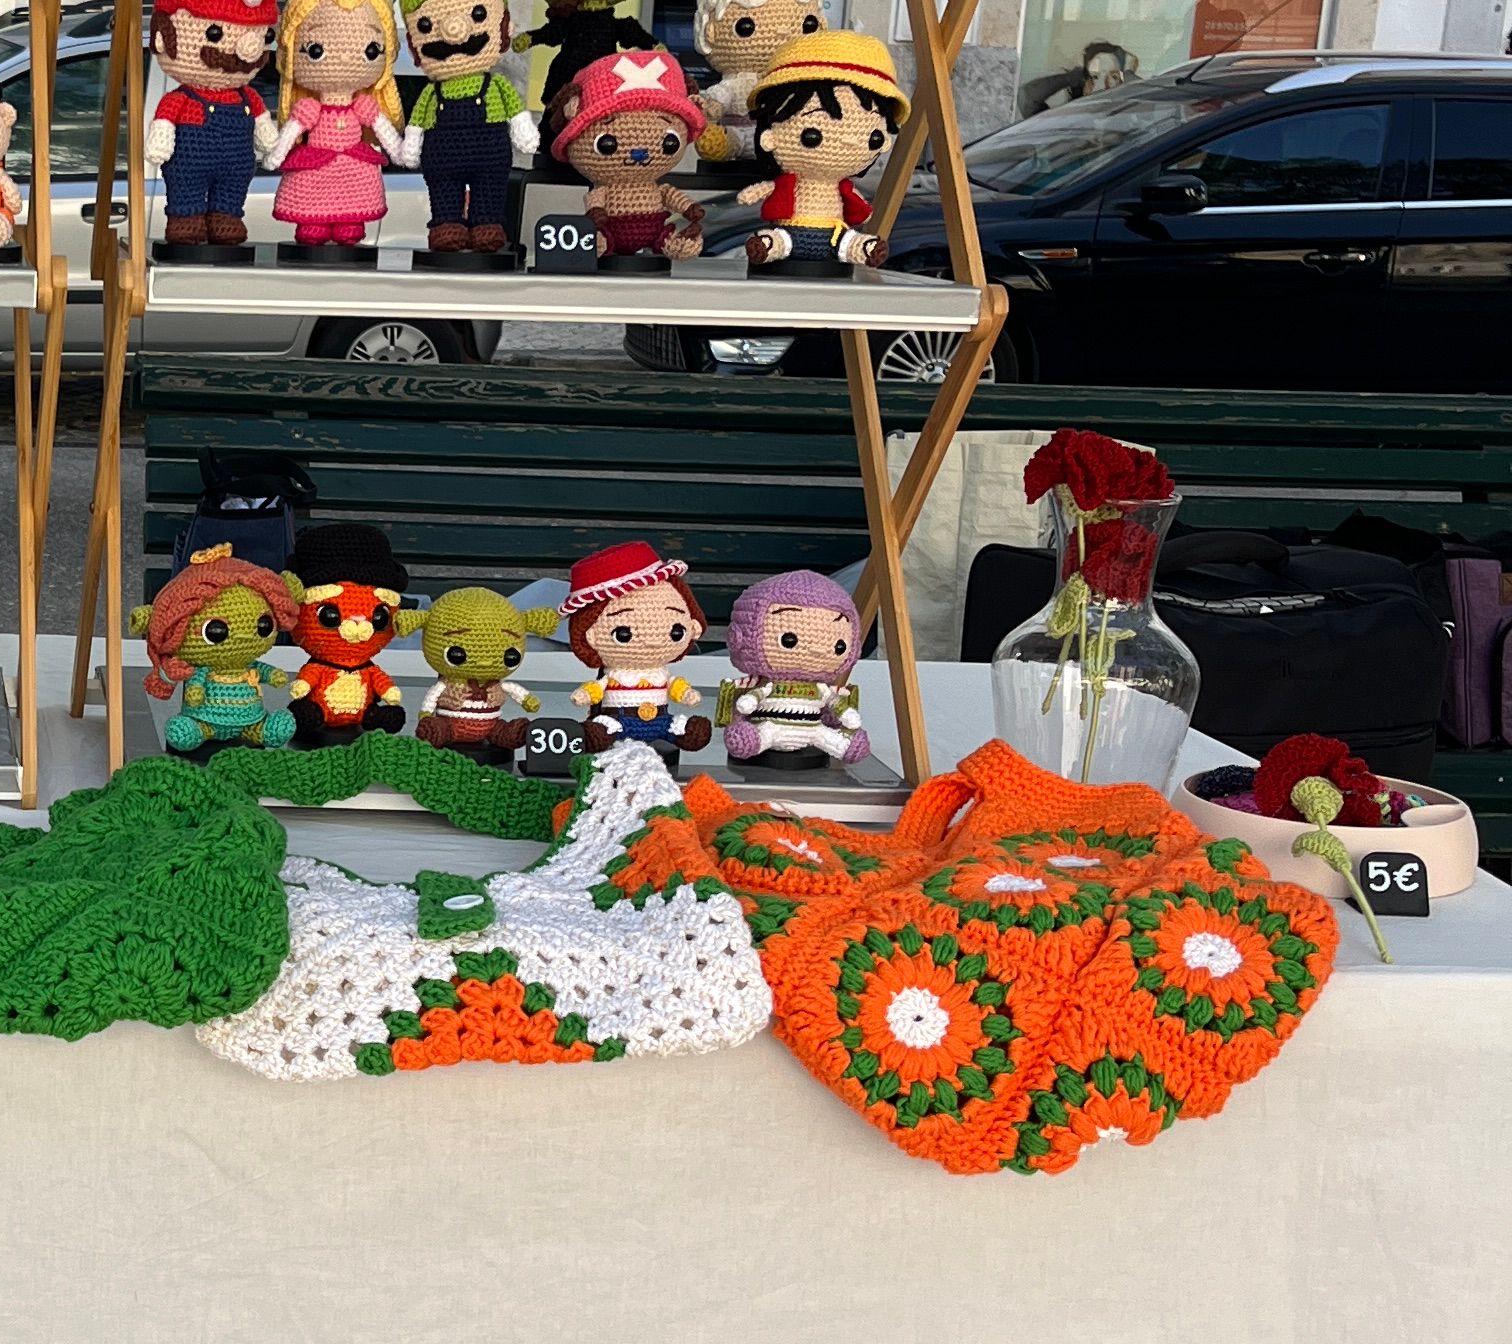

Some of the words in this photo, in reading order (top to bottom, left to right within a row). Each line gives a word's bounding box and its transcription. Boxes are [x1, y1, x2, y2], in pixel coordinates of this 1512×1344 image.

[539, 224, 595, 251] 30€
[530, 728, 583, 754] 30€
[1368, 861, 1420, 892] 5€
